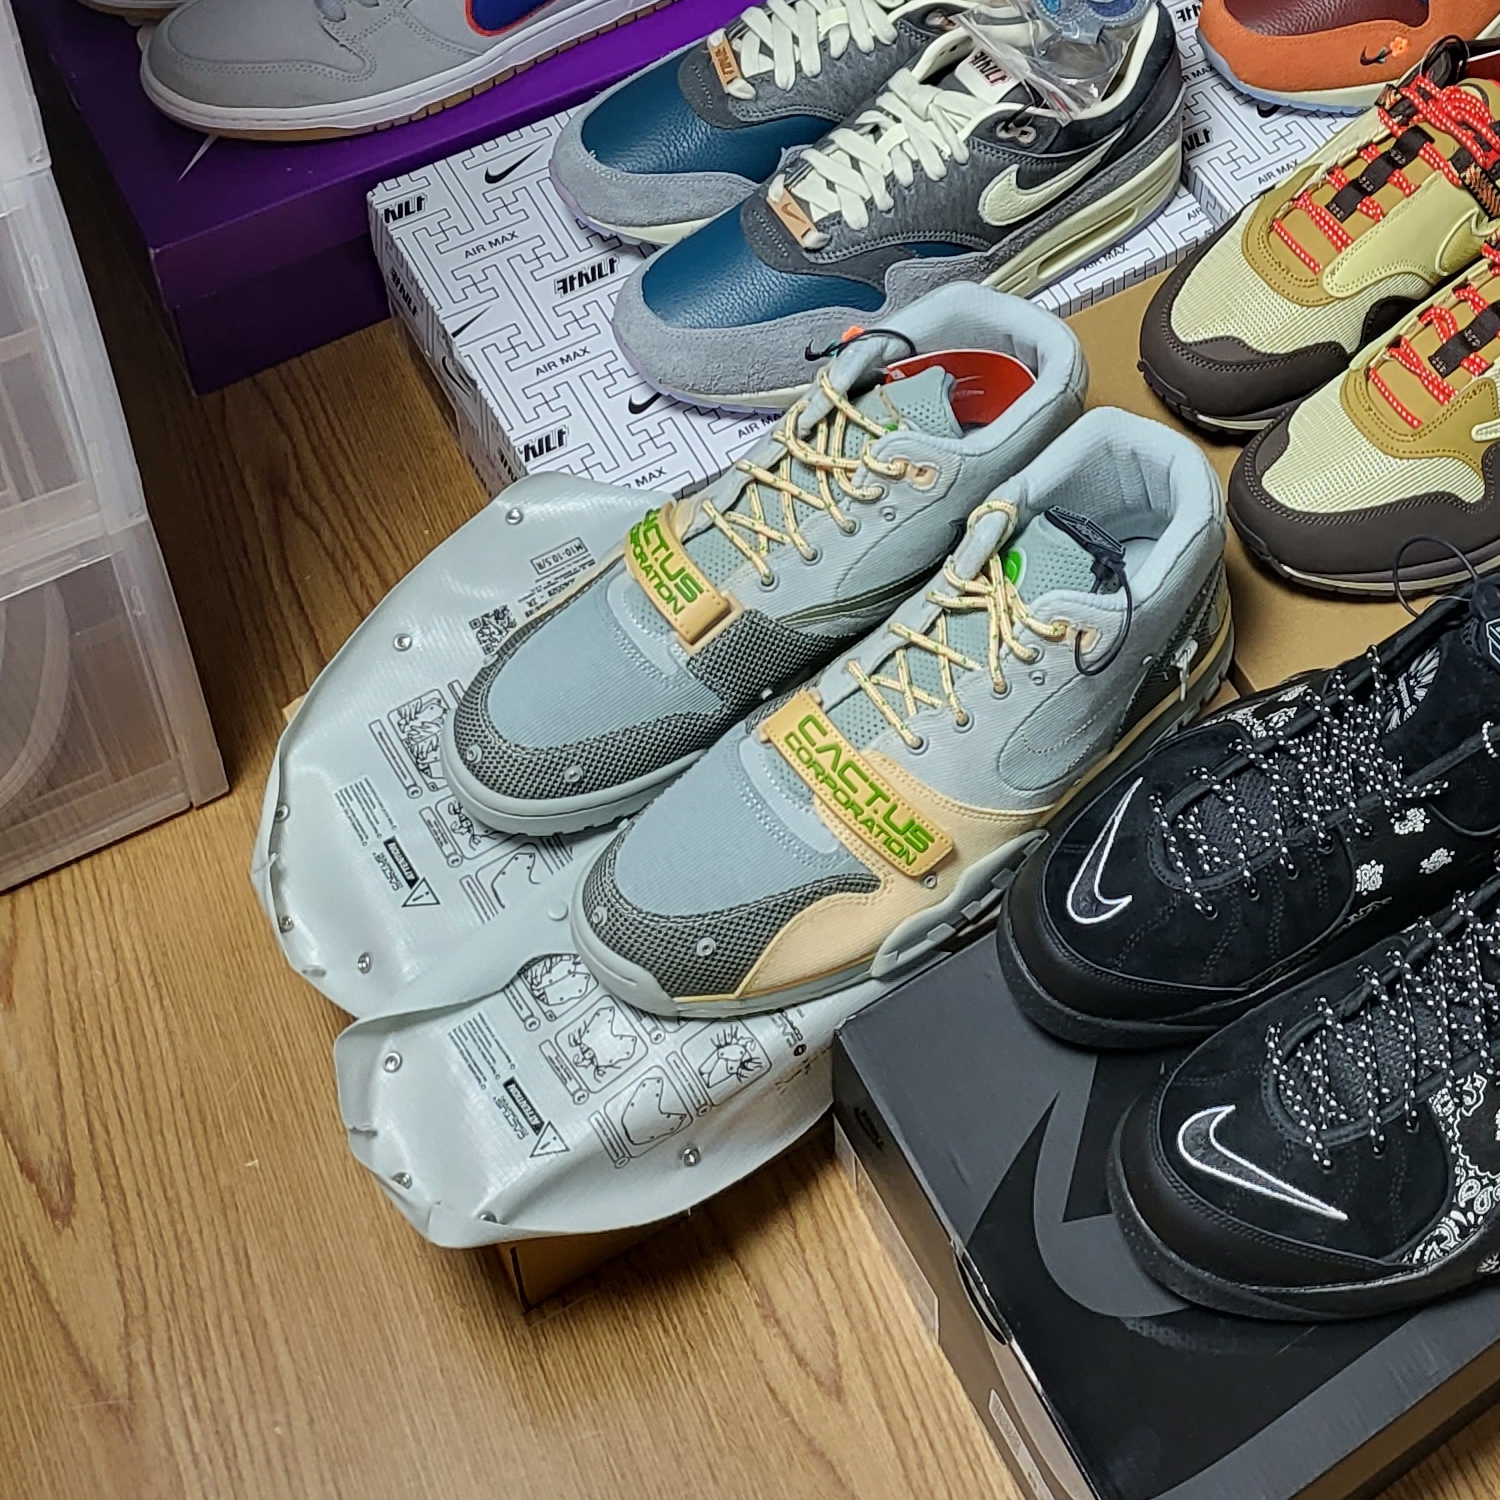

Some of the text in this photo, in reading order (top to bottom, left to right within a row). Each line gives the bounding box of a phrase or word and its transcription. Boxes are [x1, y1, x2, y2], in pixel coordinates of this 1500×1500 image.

[1192, 63, 1216, 80] MAX
[1257, 159, 1300, 186] AIR MAX
[464, 230, 519, 259] AIR MAX
[535, 346, 590, 376] AIR MAX
[738, 411, 785, 439] AIR MA
[634, 467, 667, 488] MAX
[784, 731, 917, 867] CORPORATION
[388, 841, 415, 881] ATTENTION
[507, 1084, 540, 1126] ATTENTION
